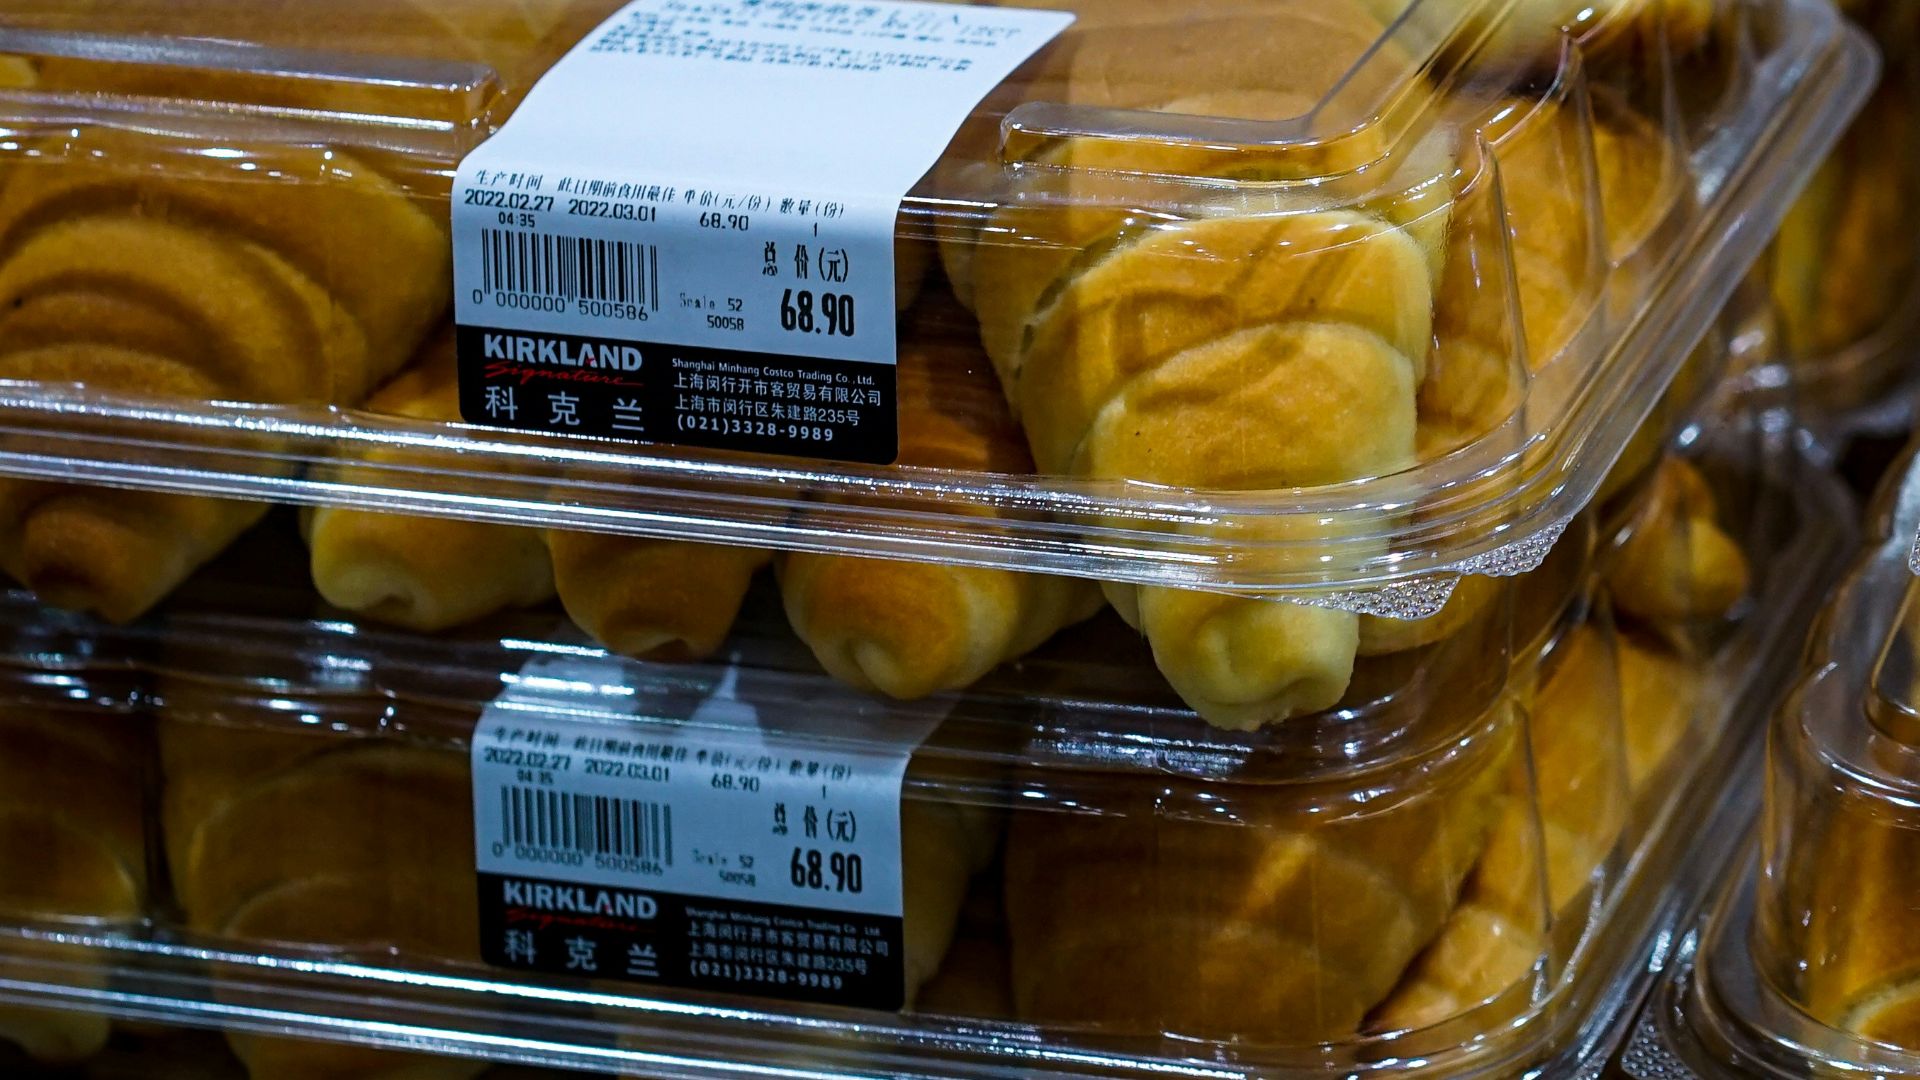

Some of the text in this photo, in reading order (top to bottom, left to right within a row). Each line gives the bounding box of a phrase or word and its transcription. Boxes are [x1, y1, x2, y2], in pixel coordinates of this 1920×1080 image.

[464, 188, 818, 238] 2022.02.27 2022.03.01 68.90 1
[498, 211, 536, 229] 04:35
[472, 289, 649, 322] 0 000000 500586
[727, 297, 743, 313] 52
[780, 288, 855, 337] 68.90
[484, 333, 643, 373] KIRKLAND
[671, 357, 716, 372] Shanghai
[718, 362, 760, 377] Minhang
[763, 366, 794, 379] Costco
[797, 369, 832, 384] Trading
[483, 360, 645, 387] Signature
[674, 371, 881, 407] 上海闵行开市客贸易有限公司
[485, 385, 645, 432] 科克兰
[674, 393, 861, 427] 上海市闵行区朱建路235号
[677, 413, 834, 442] (021)3328-9989
[484, 746, 571, 771] 2022.02.27
[584, 757, 670, 782] 2022.03.01
[711, 773, 760, 793] 68.90
[492, 841, 504, 858] 0
[790, 846, 864, 894] 68.90
[503, 880, 658, 919] KIRKLAND
